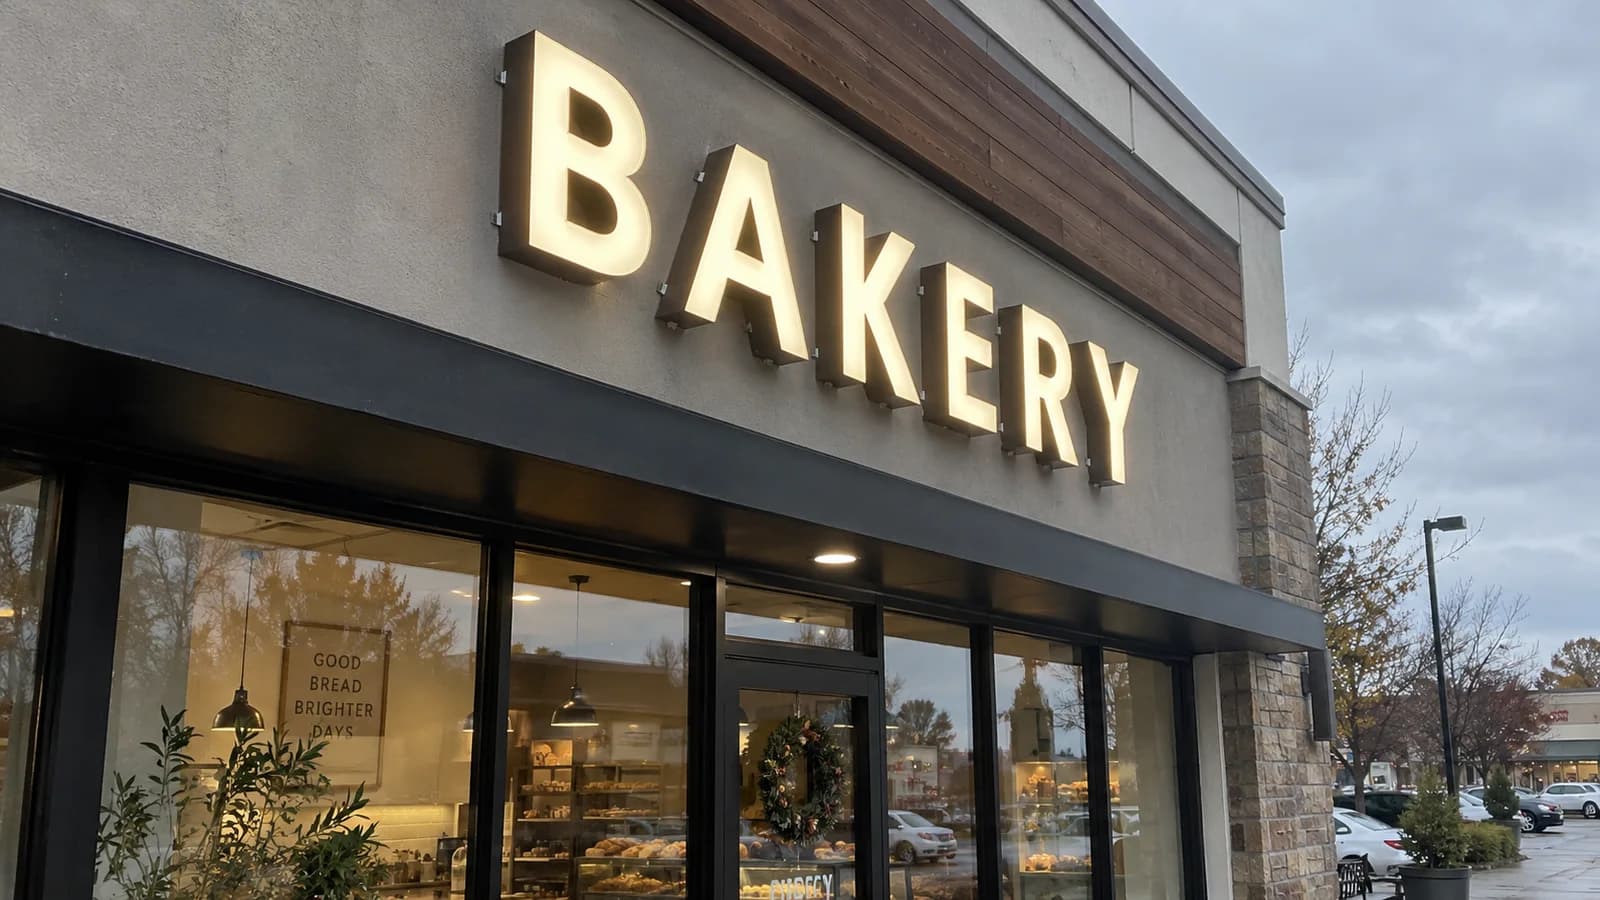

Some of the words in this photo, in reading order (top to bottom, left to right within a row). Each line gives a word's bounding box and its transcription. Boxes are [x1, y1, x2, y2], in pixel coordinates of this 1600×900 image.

[528, 30, 1140, 485] BAKERY
[313, 652, 361, 670] GOOD
[310, 675, 362, 693] BREAD
[294, 700, 373, 718] BRIGHTER
[312, 724, 353, 739] DAYS
